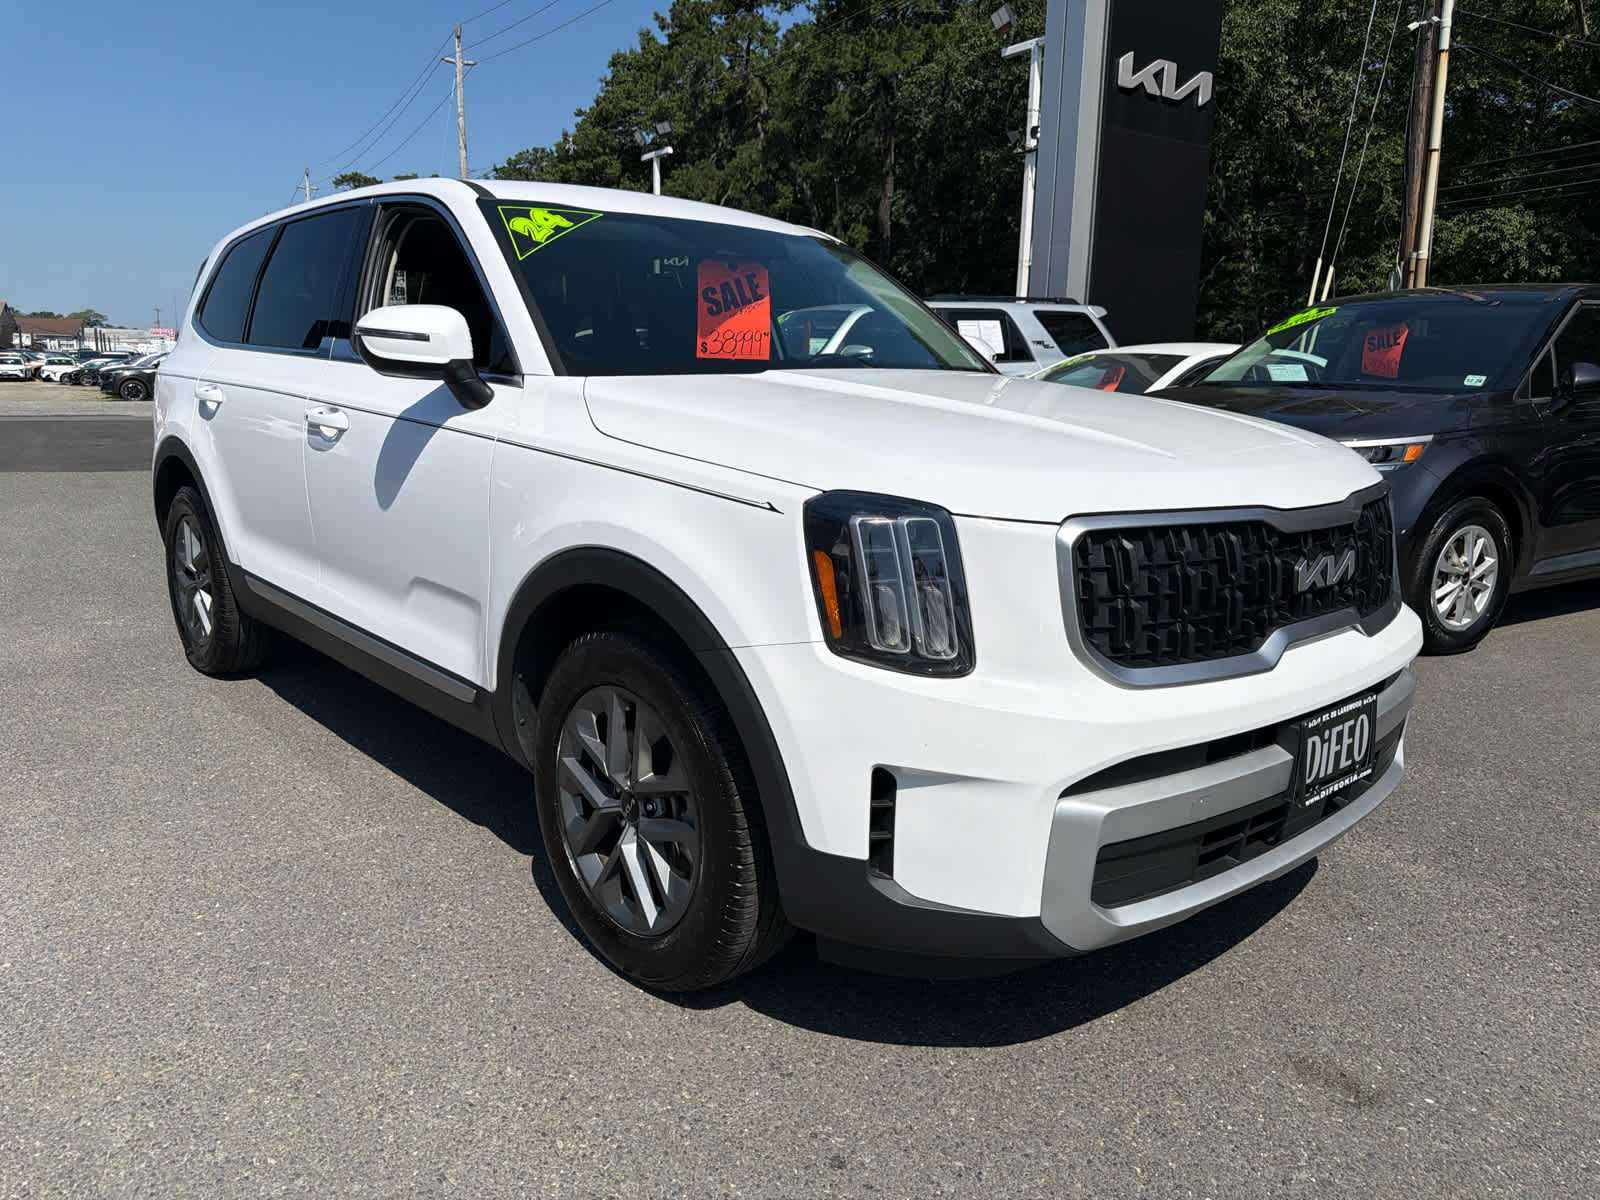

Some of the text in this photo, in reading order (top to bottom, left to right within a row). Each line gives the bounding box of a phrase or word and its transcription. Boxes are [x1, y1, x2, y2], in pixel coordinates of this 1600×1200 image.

[1118, 51, 1213, 106] KIA
[509, 208, 575, 243] 24
[701, 272, 766, 317] SALE
[1295, 549, 1356, 592] KIA
